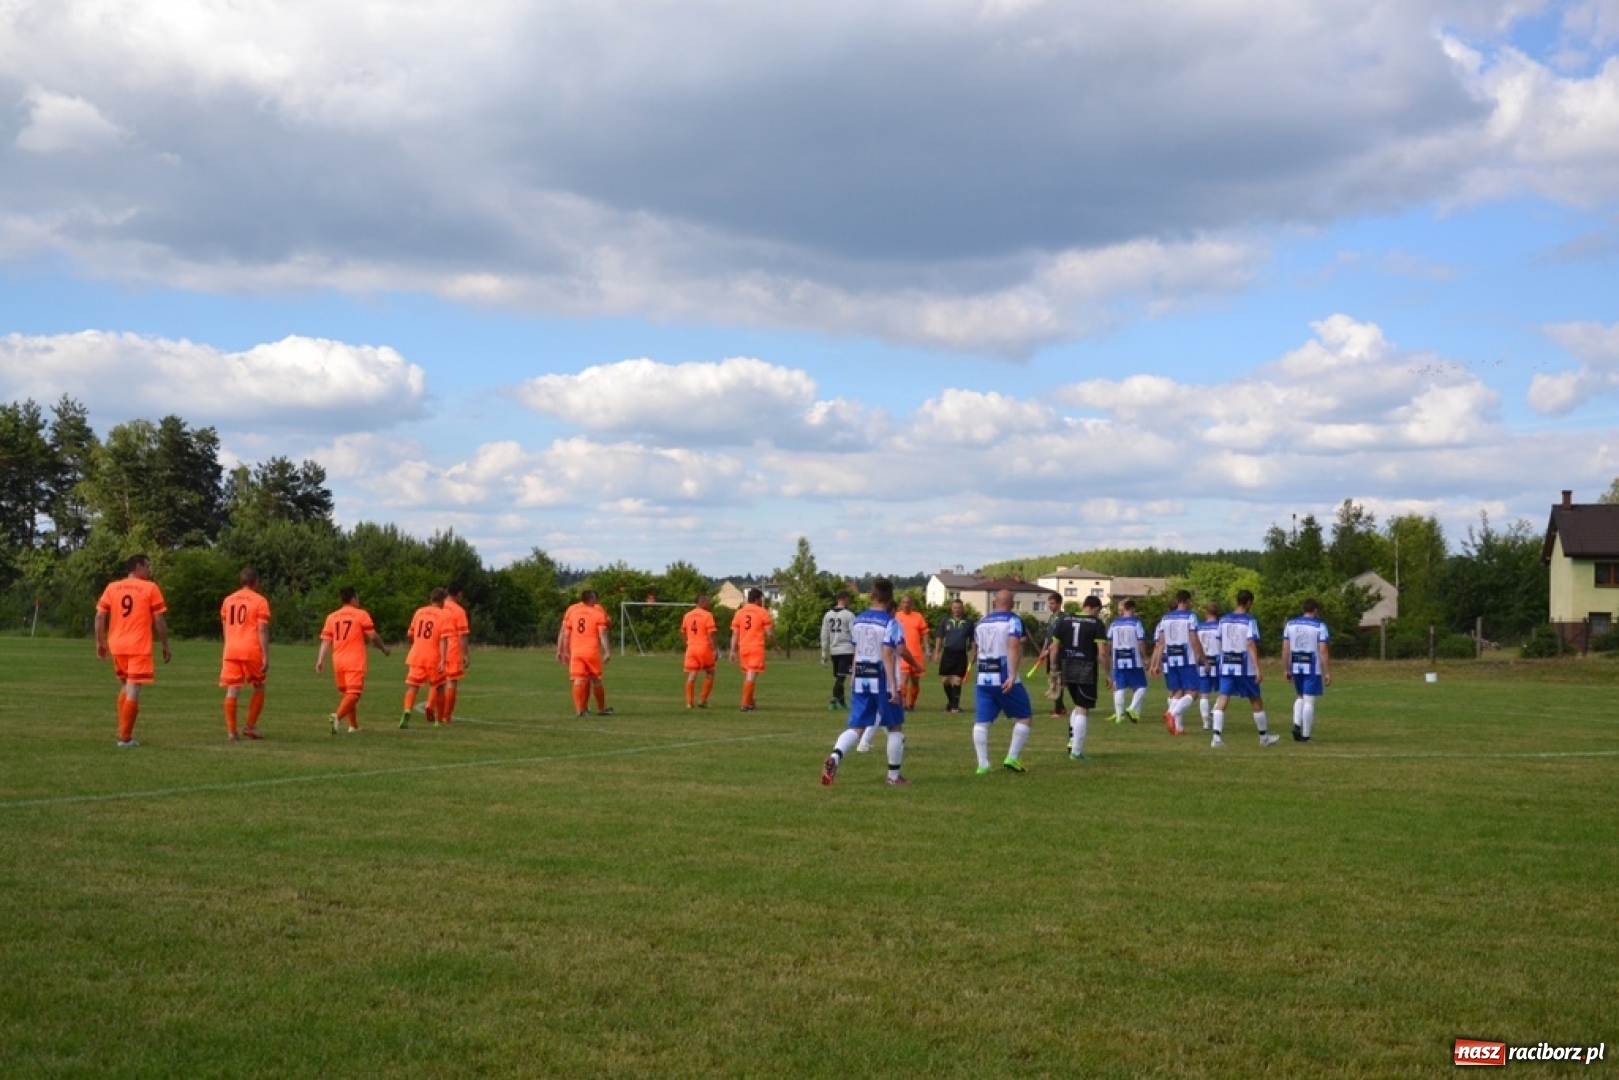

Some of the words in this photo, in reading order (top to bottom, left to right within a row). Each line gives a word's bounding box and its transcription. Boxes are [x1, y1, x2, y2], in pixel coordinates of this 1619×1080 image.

[121, 594, 133, 618] 9
[230, 604, 247, 626] 10
[335, 620, 352, 641] 17
[417, 620, 434, 639] 18
[577, 617, 585, 634] 8
[690, 619, 698, 635] 4
[744, 614, 752, 630] 3
[829, 617, 842, 633] 22
[1071, 622, 1080, 647] 1
